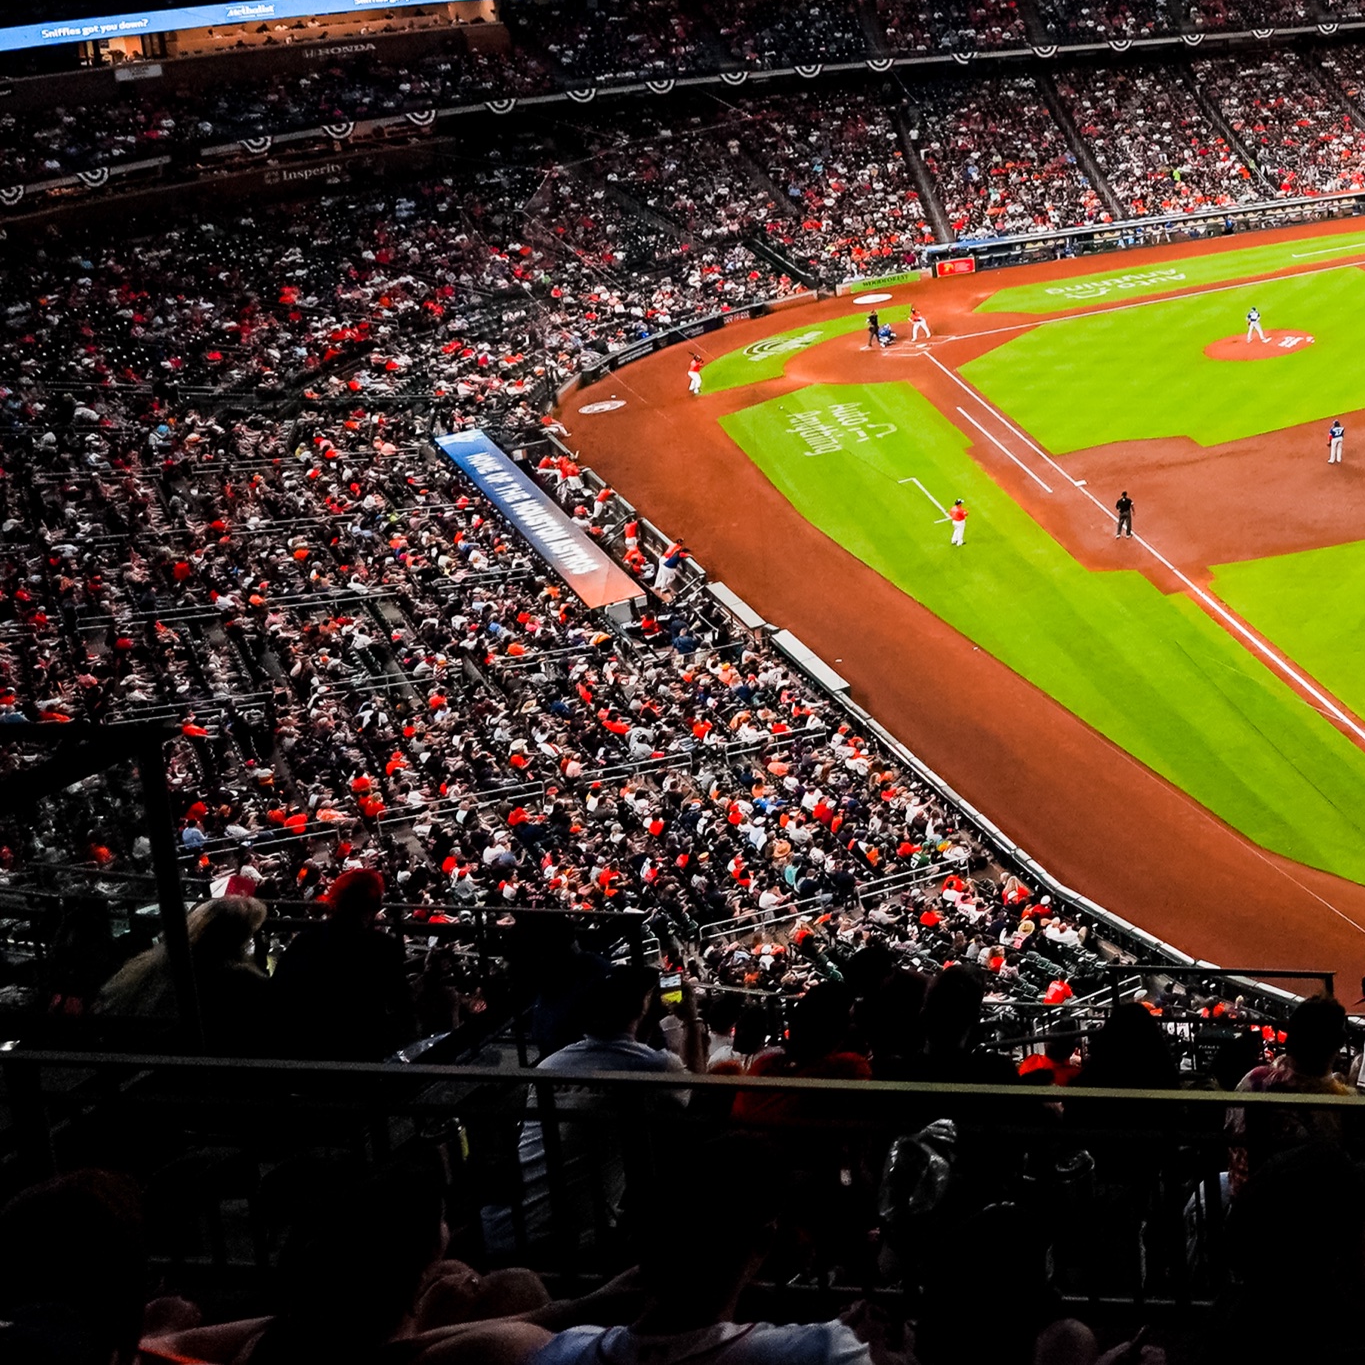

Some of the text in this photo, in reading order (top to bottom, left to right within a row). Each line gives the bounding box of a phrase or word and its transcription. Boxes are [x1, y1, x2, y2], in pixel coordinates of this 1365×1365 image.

[41, 18, 149, 40] Sniffles got you down?
[316, 43, 376, 56] HONDA
[282, 163, 342, 180] Insperity
[786, 410, 842, 457] Anything
[466, 451, 600, 576] HOME OF THE HOUSTON ASTROS
